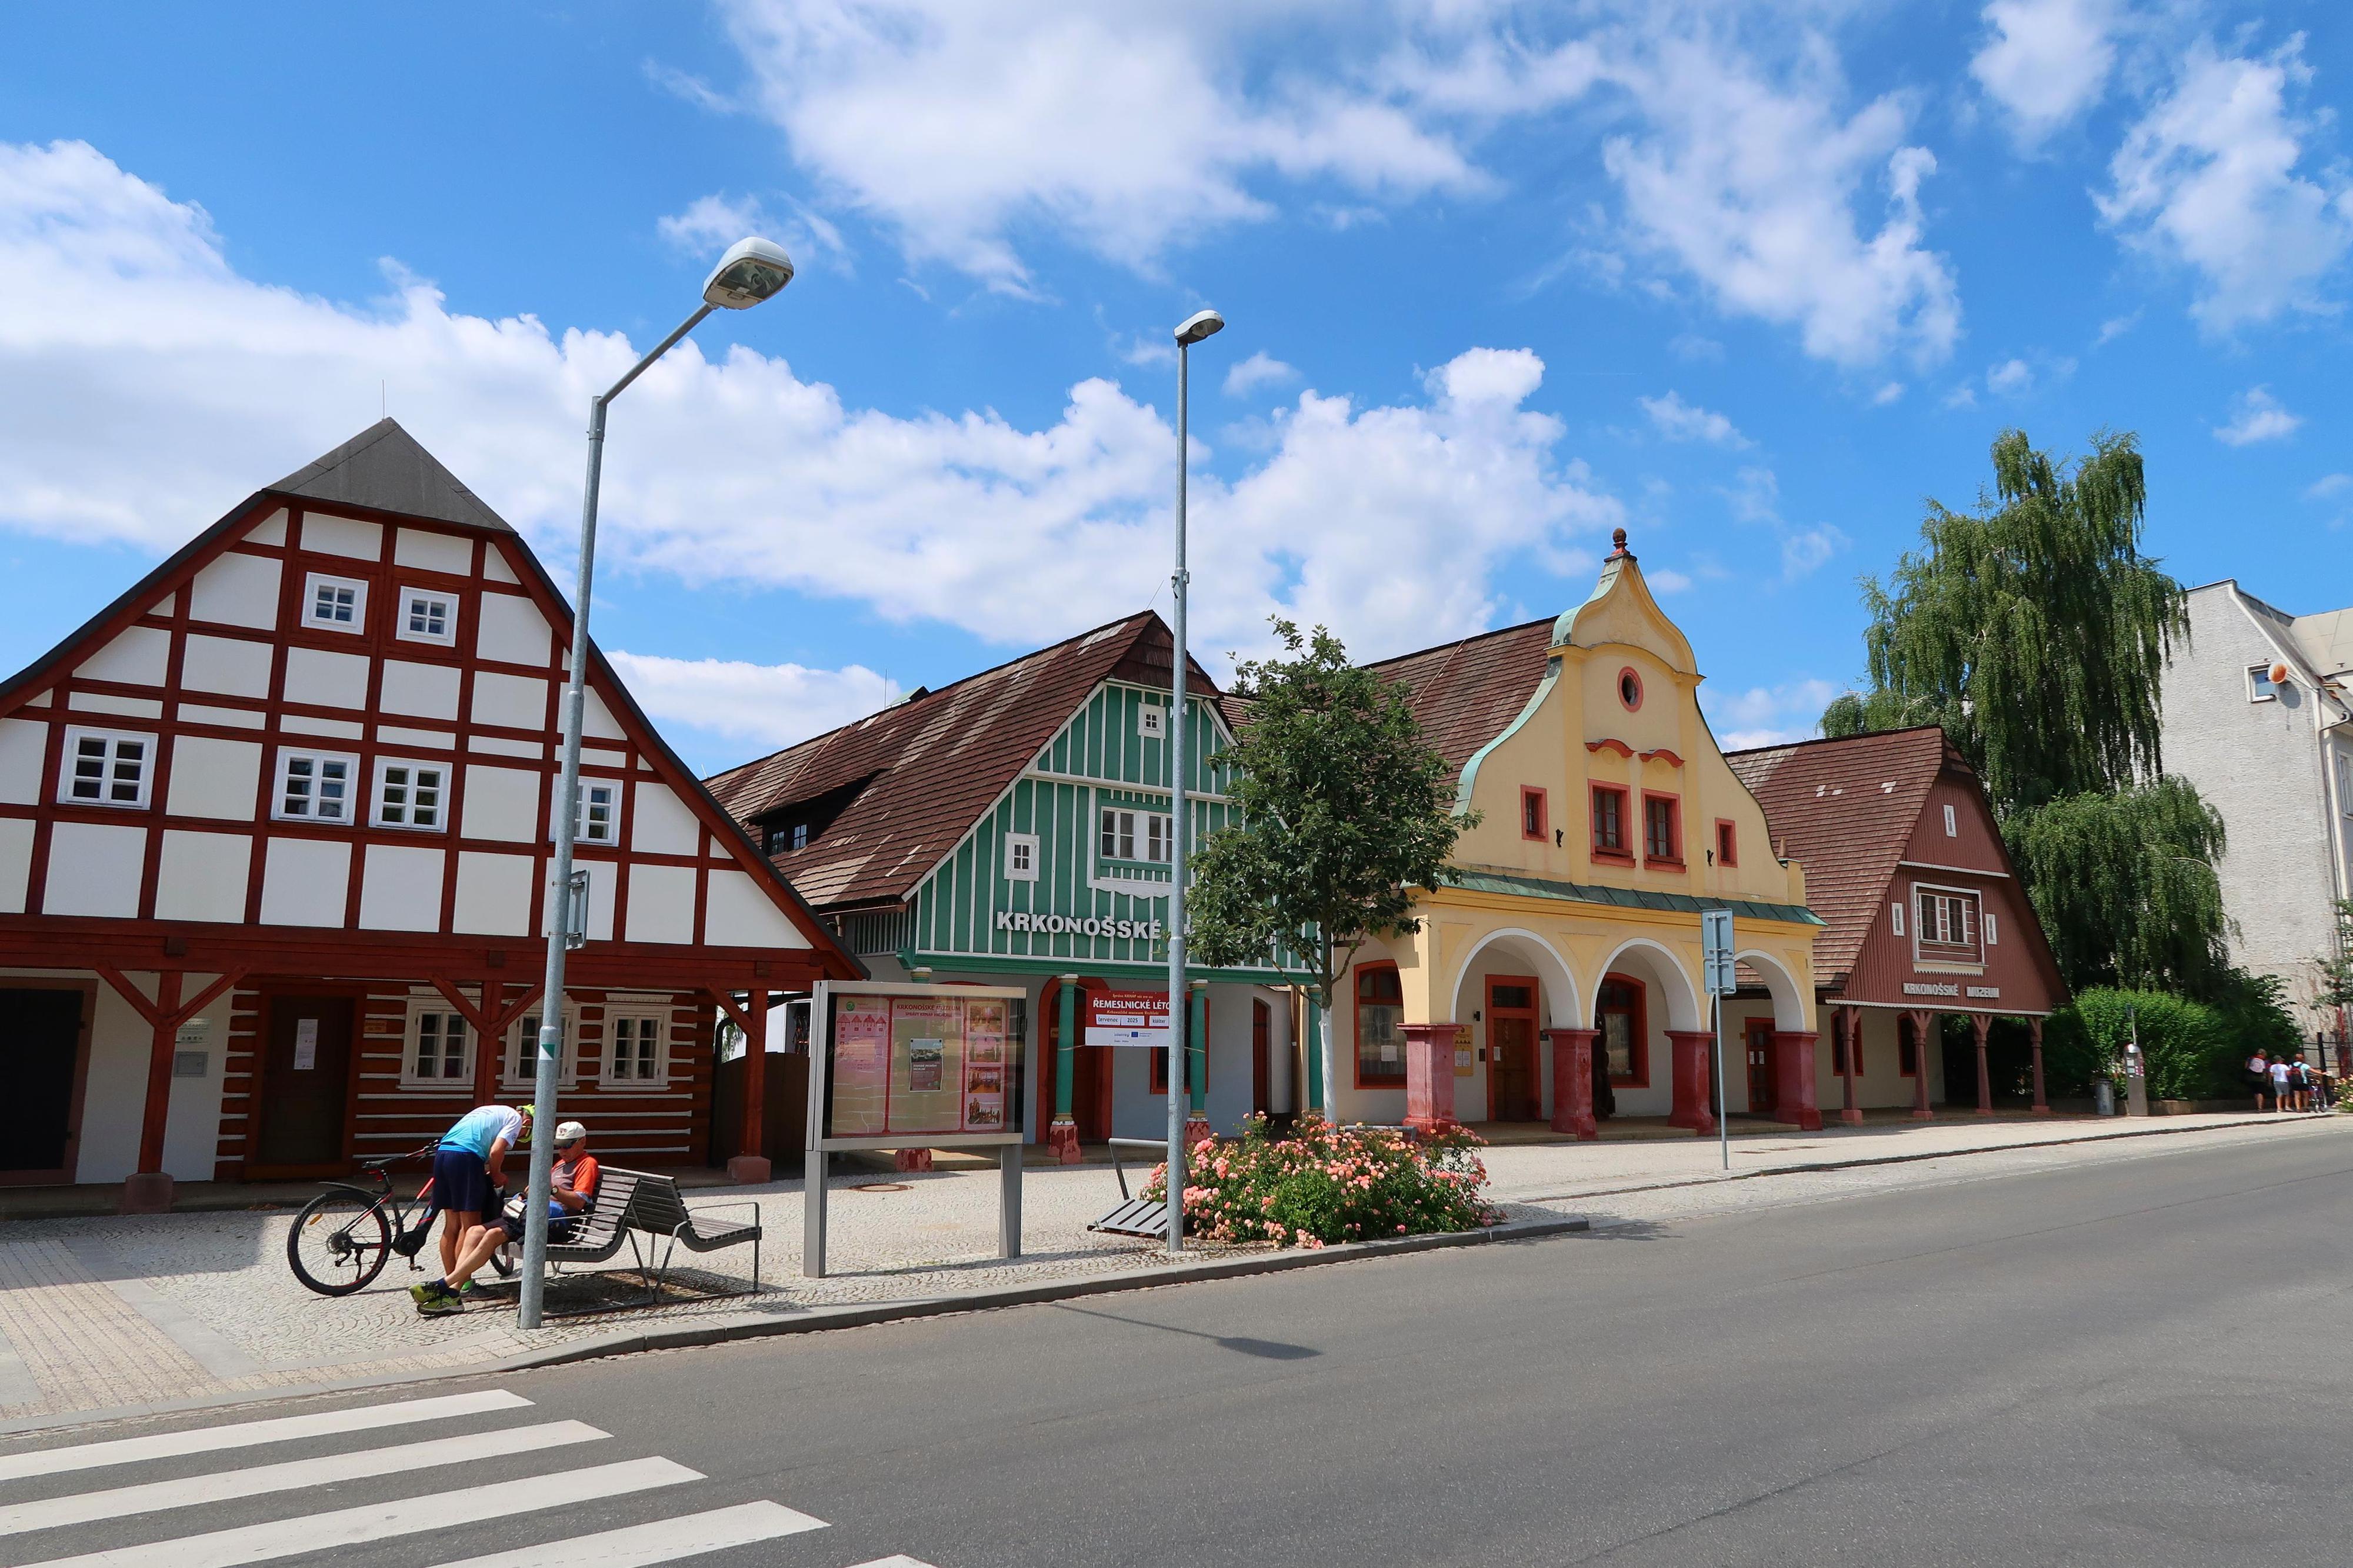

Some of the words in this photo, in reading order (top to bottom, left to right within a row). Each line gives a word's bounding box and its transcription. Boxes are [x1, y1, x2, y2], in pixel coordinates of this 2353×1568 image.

[996, 911, 1161, 940] KRKONOŠSKÉ
[1903, 982, 1958, 996] KRKONOŠSKÉ
[1093, 997, 1151, 1009] ŘEMESLNICKÉ
